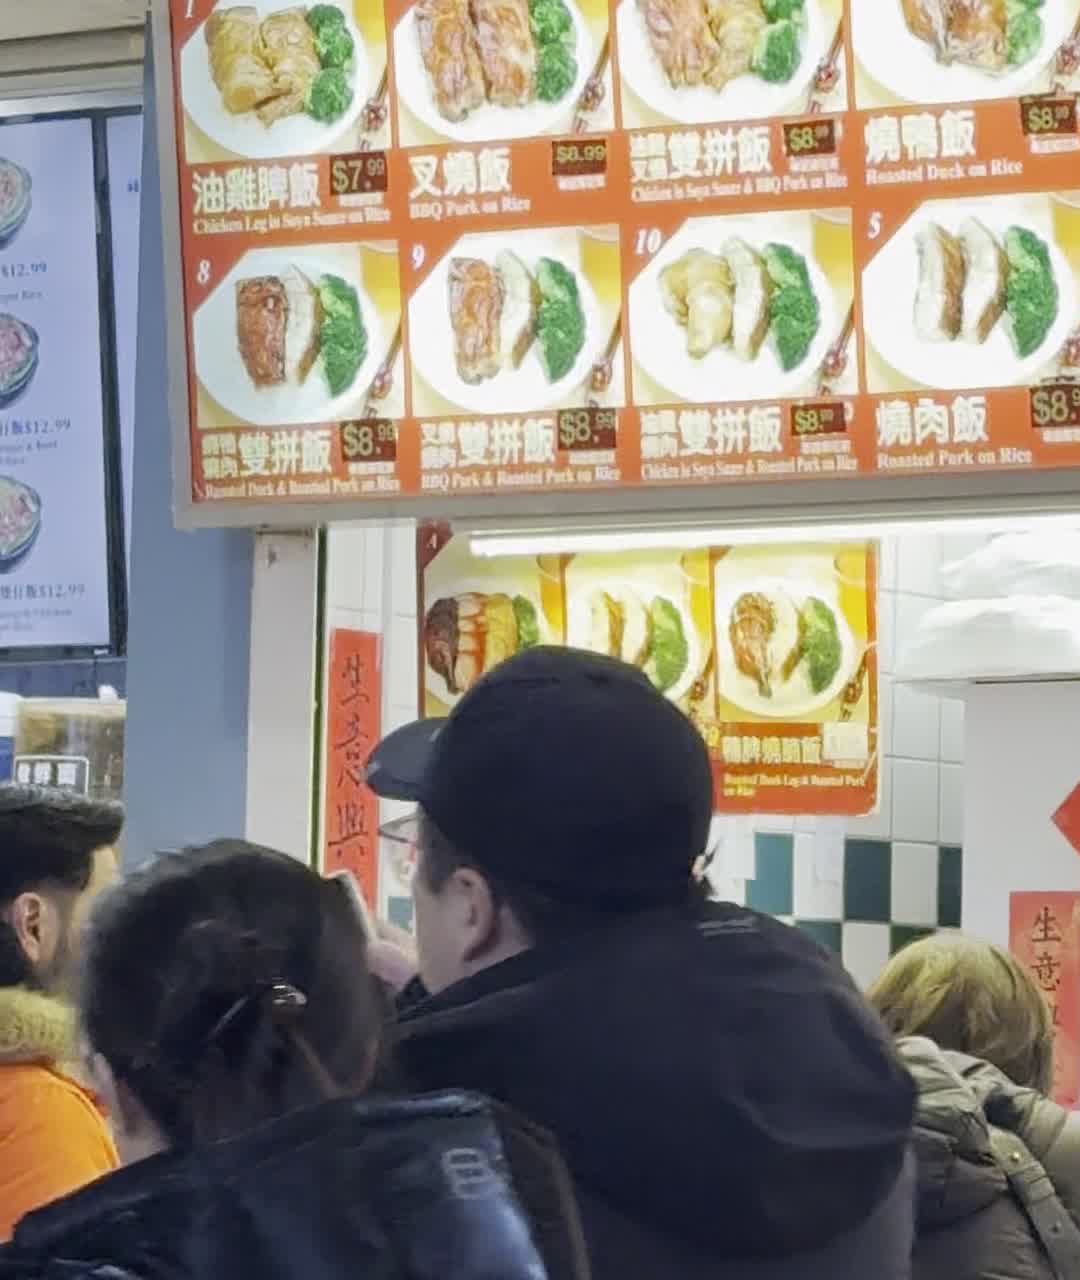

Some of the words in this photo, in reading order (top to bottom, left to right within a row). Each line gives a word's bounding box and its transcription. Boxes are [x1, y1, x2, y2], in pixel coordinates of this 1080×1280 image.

[408, 147, 512, 199] 叉燒飯
[865, 166, 923, 185] Roasted
[927, 163, 964, 181] Duck
[967, 163, 987, 178] on
[990, 158, 1023, 176] Rice
[868, 213, 881, 238] 5
[635, 230, 661, 254] 10
[411, 245, 426, 269] 9
[197, 259, 211, 283] 8
[876, 396, 989, 447] 燒肉飯
[877, 450, 934, 468] Roasted
[938, 448, 974, 466] Pork
[977, 449, 996, 464] on
[1000, 446, 1032, 463] Rice
